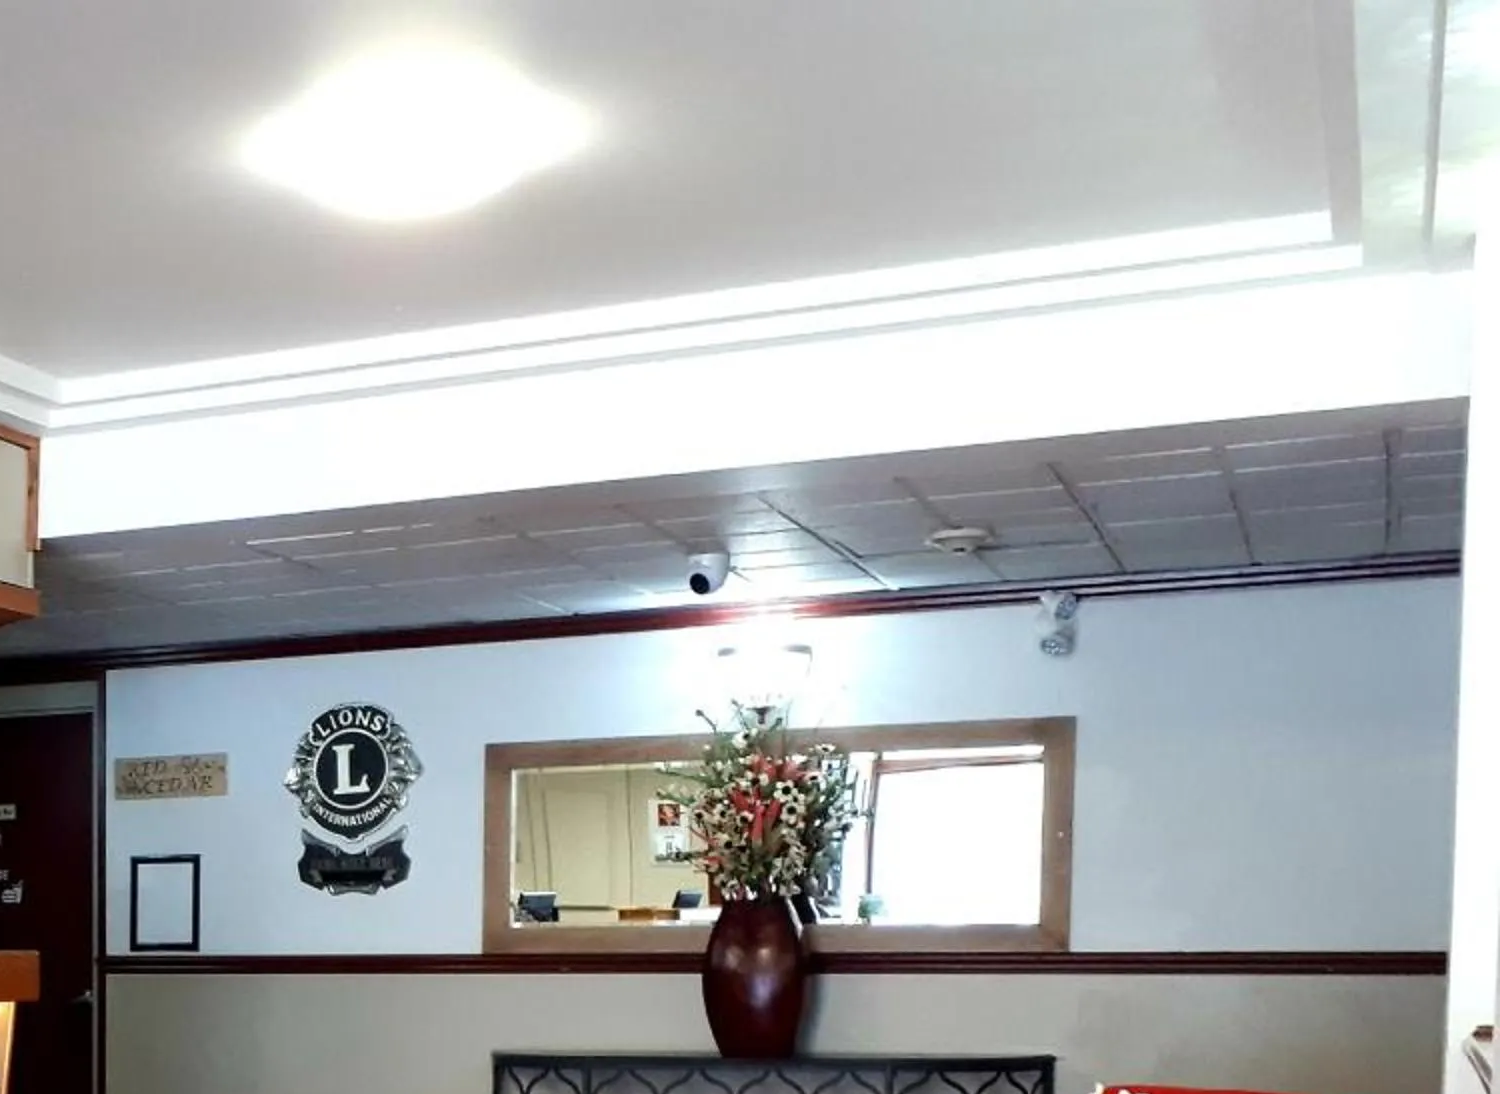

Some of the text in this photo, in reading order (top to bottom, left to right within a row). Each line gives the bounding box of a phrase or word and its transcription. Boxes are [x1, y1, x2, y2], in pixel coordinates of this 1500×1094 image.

[315, 708, 386, 737] LIONS
[331, 743, 371, 795] L
[313, 796, 393, 827] INTERNATIONAL
